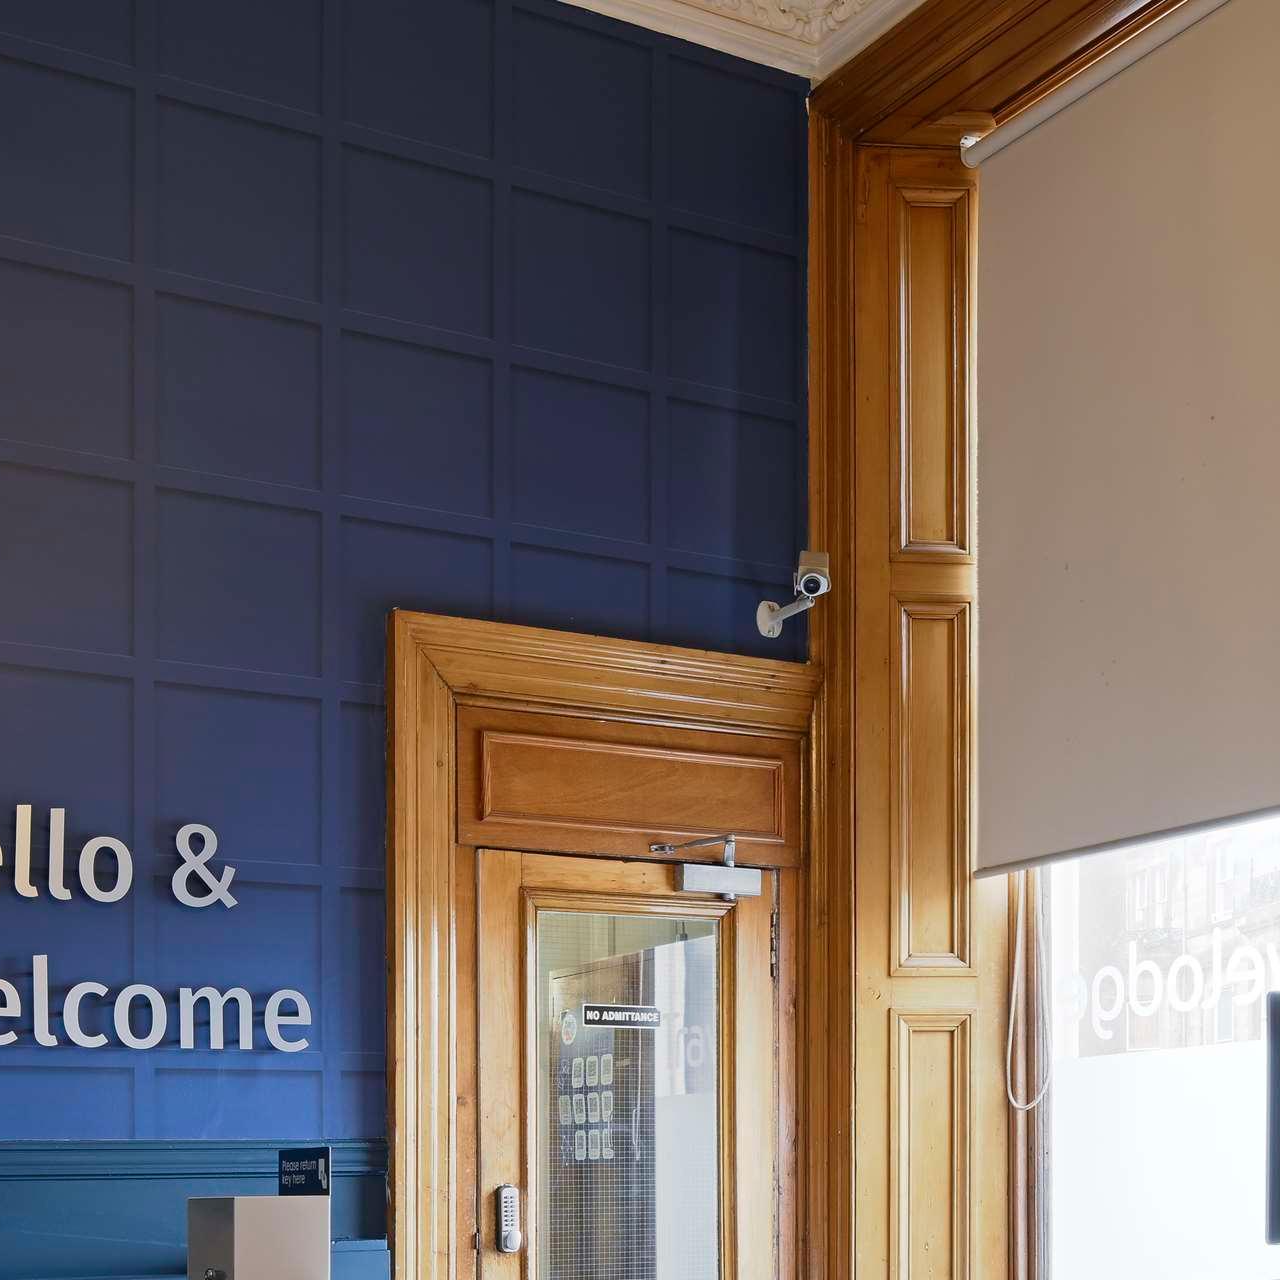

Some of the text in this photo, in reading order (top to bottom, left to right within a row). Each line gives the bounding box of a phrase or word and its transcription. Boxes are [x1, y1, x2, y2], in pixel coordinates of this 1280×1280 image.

[171, 823, 239, 909] &
[586, 1010, 660, 1023] NO ADMITTANCE
[282, 1159, 317, 1171] Please return
[282, 1173, 305, 1188] key here
